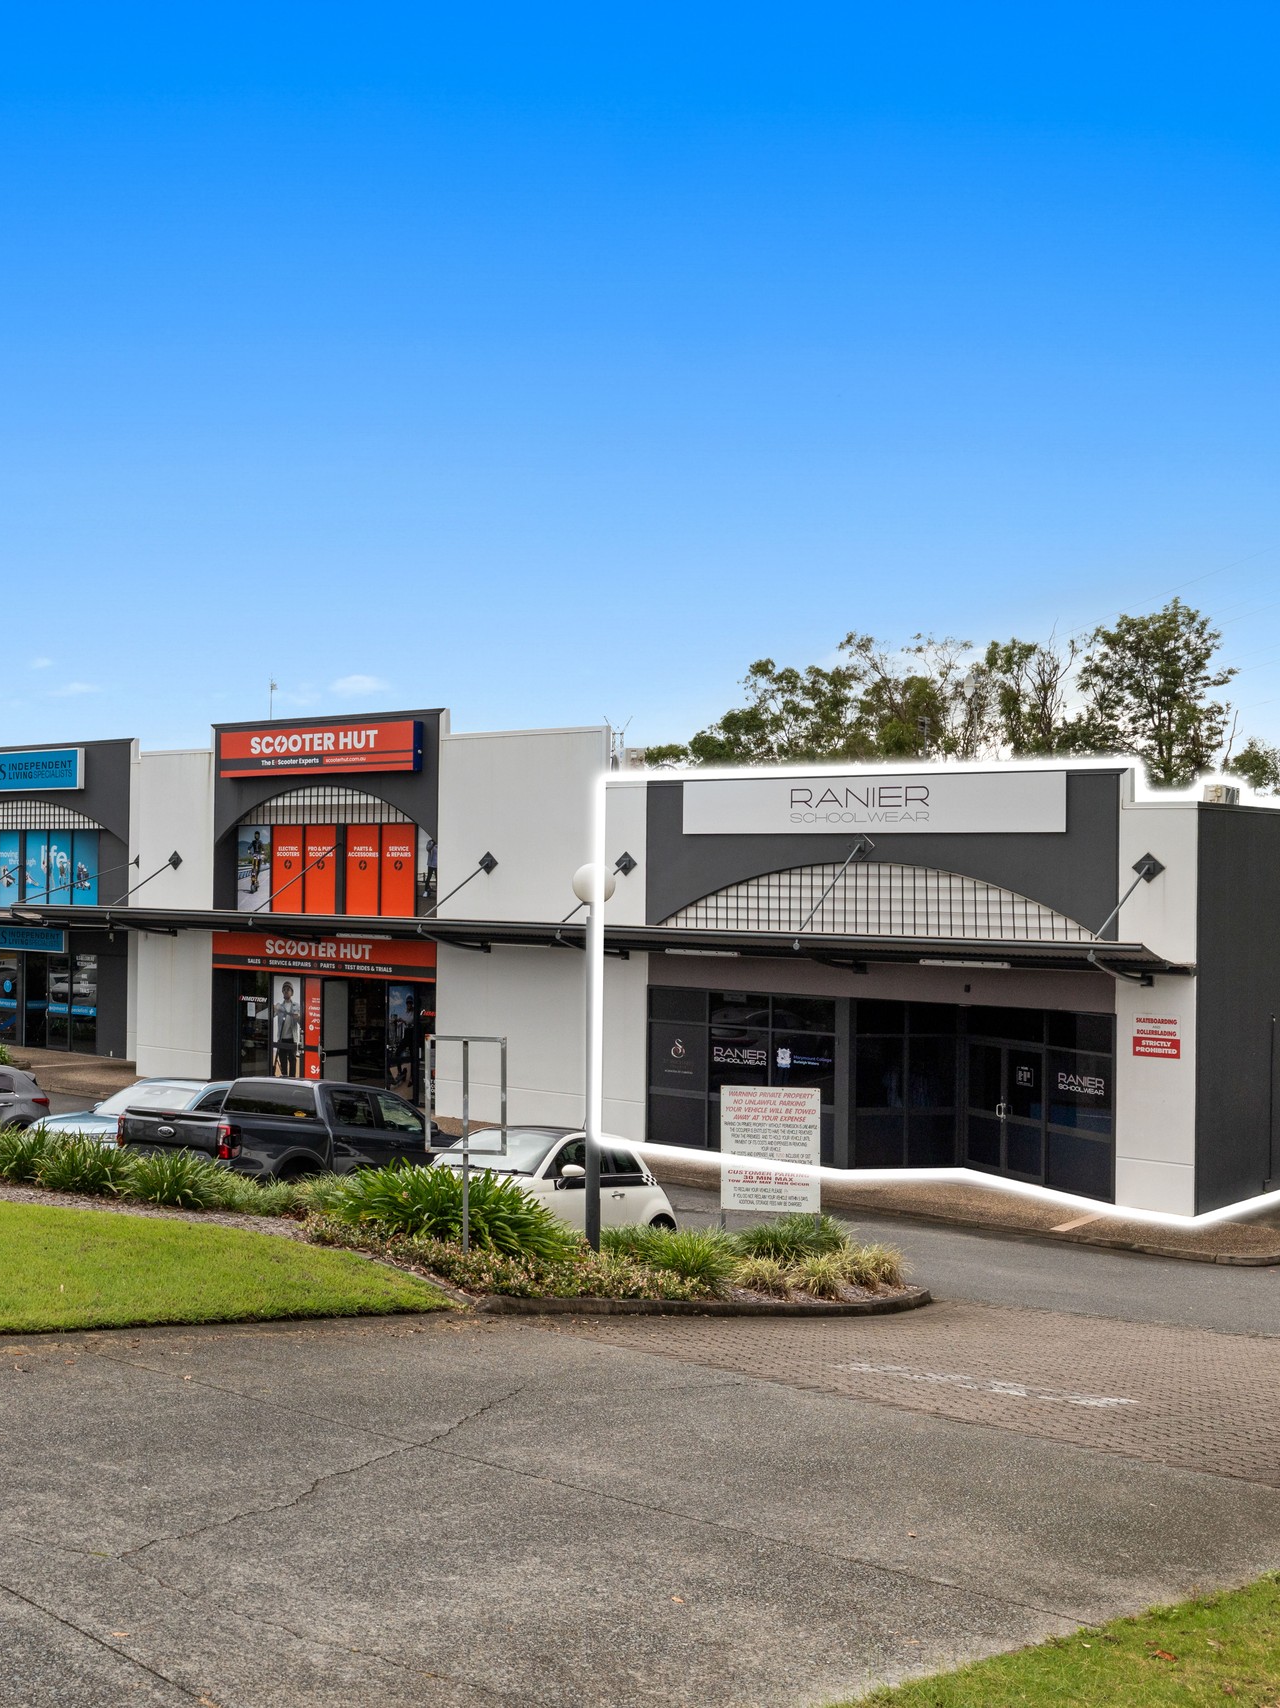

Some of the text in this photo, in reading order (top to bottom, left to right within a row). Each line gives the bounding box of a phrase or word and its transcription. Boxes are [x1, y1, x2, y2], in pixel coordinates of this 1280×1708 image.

[250, 730, 378, 754] SCOOTER HUT
[9, 760, 72, 770] INDEPENDENT
[9, 769, 72, 779] LIVING SPECIALISTS
[791, 786, 929, 808] RANIER
[790, 812, 929, 823] SCHOOLWEAR
[9, 931, 60, 939] INDEPENDENT
[266, 940, 372, 960] SCOOTER HUT
[714, 1047, 766, 1060] RANIER
[1136, 1046, 1177, 1054] PROHIBITED
[1058, 1072, 1104, 1089] RANIER
